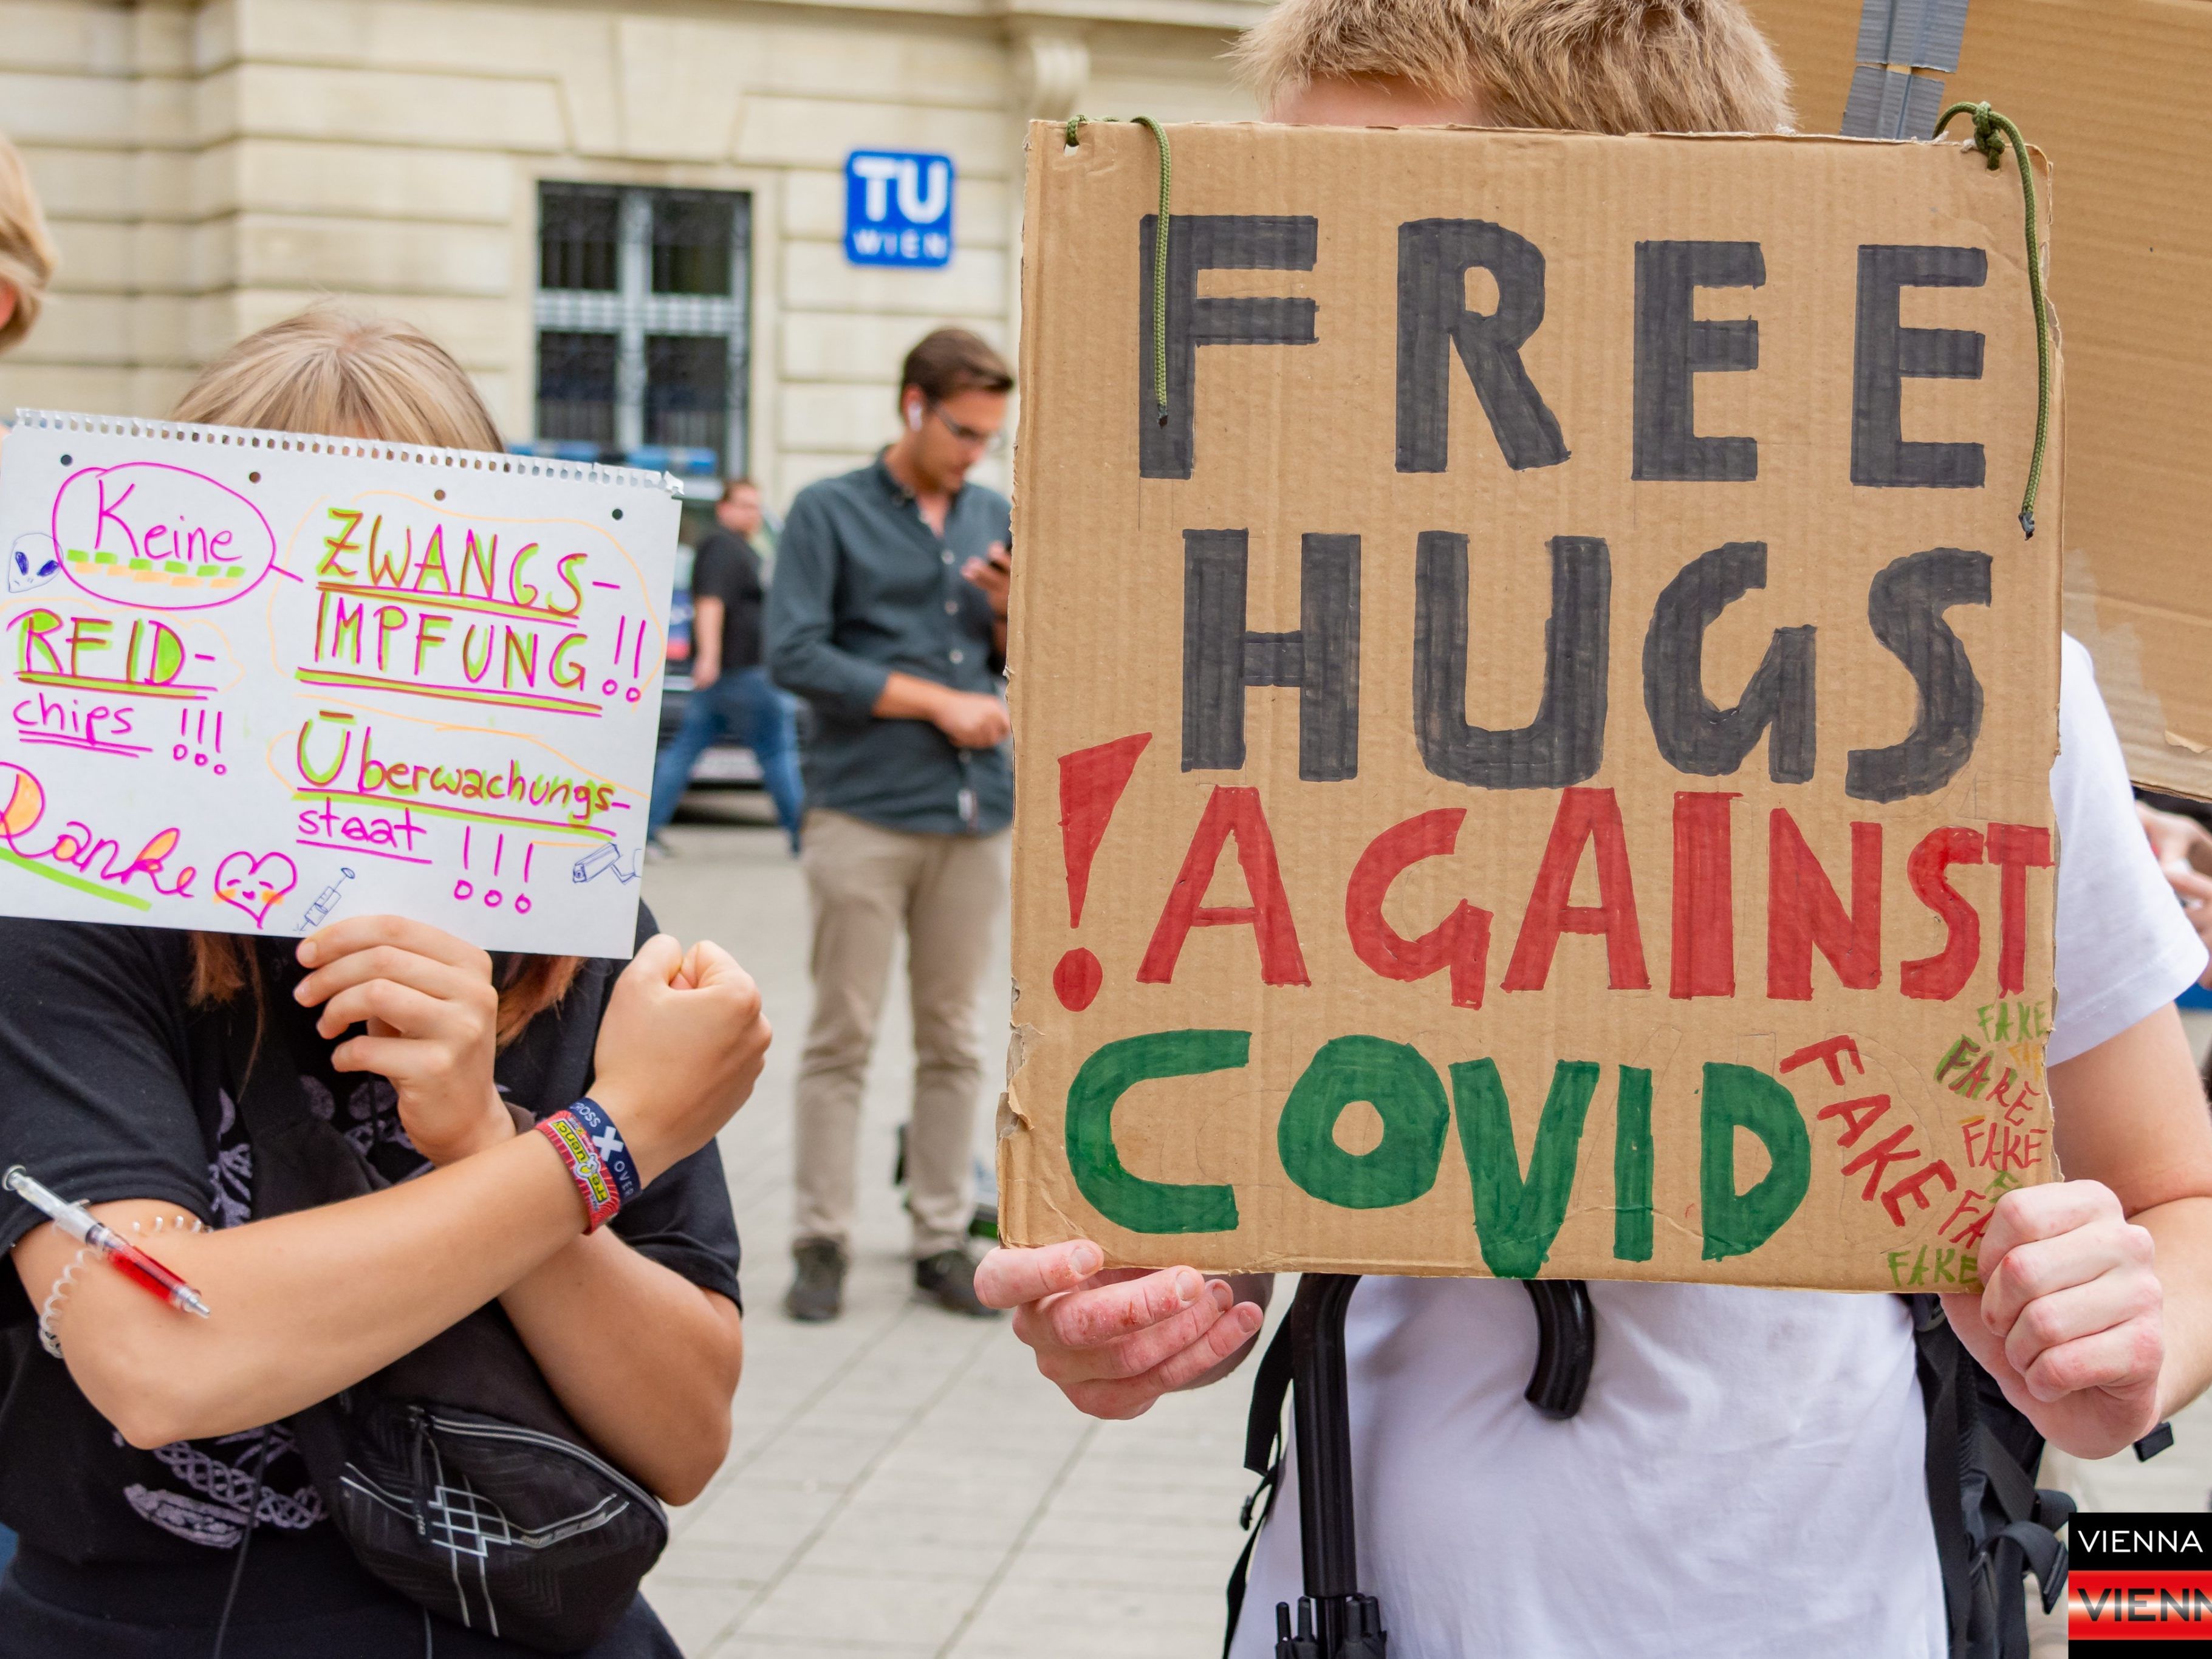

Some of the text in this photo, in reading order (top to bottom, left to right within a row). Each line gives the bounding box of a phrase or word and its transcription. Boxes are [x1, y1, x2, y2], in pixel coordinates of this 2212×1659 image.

[852, 156, 948, 224] TU
[853, 229, 948, 260] WIEN
[1139, 214, 1988, 488] FREE
[94, 479, 243, 563] Keine
[317, 508, 621, 618] ZWANGS-
[6, 608, 216, 686] RFID-
[1181, 528, 1993, 804] HUGS
[12, 693, 135, 744] chips
[298, 796, 427, 851] staat
[1977, 1001, 2046, 1043] FAKE
[1064, 1028, 1811, 1279] COVID
[1779, 1035, 1957, 1227] FAKE
[1962, 1122, 2047, 1171] FAKE
[1887, 1244, 1980, 1287] FAKE
